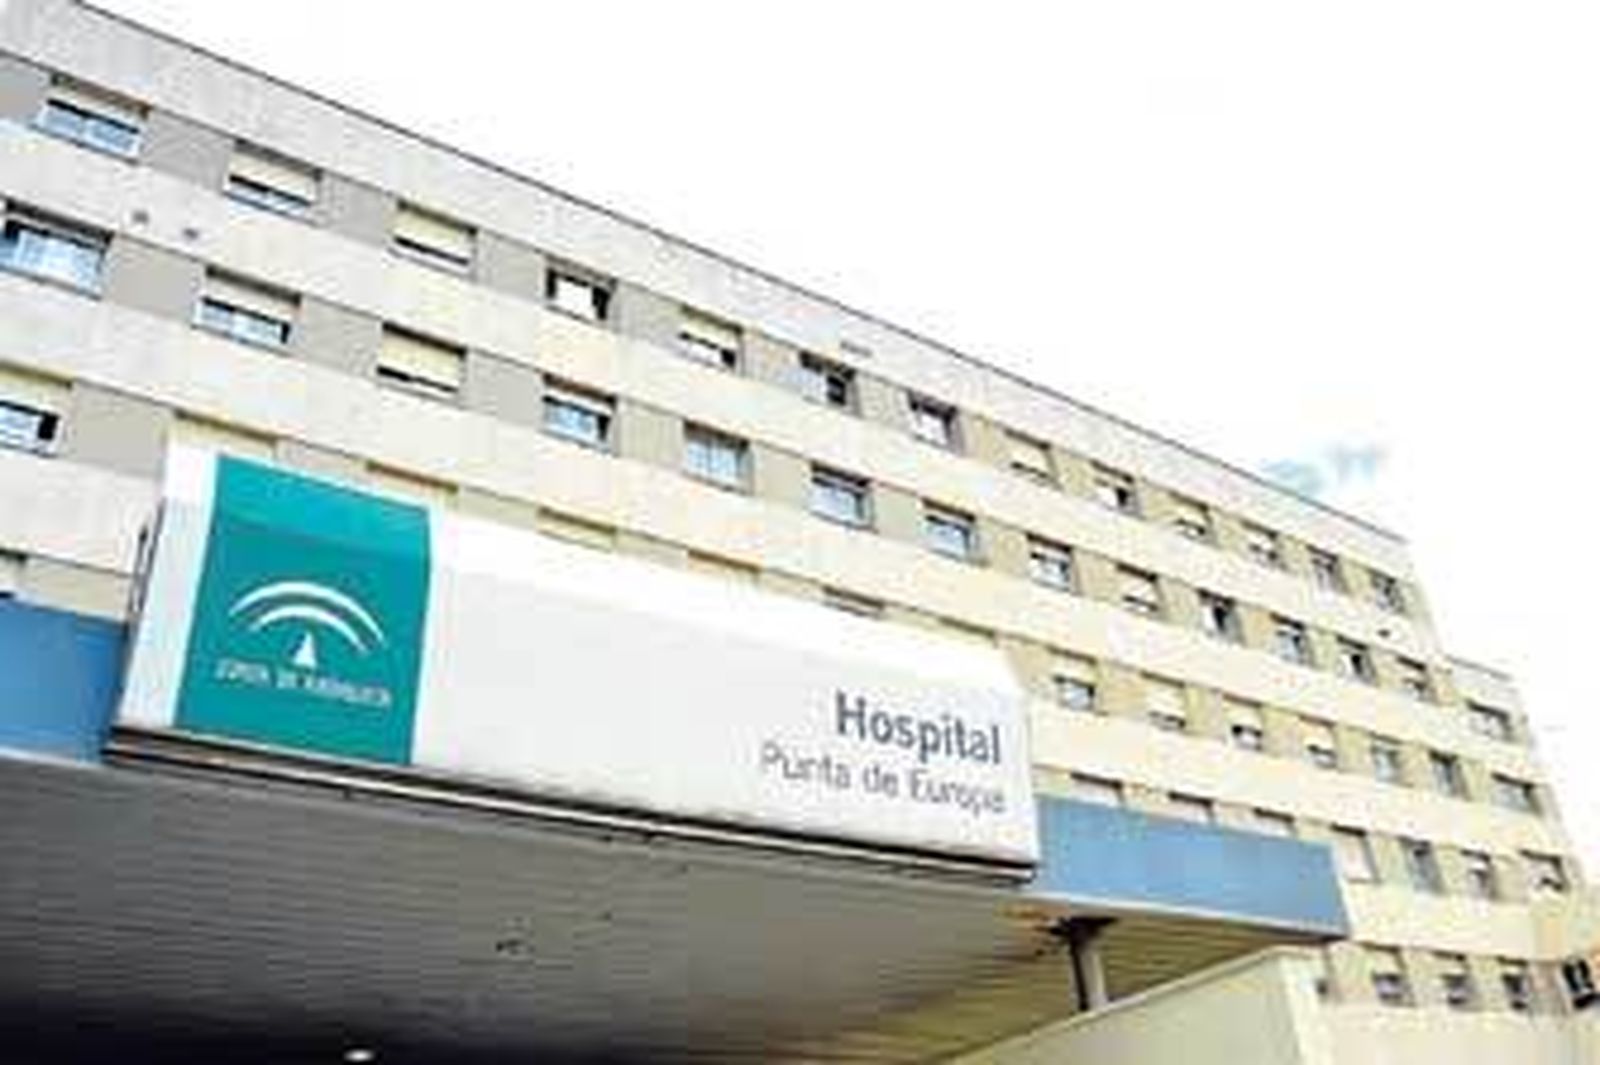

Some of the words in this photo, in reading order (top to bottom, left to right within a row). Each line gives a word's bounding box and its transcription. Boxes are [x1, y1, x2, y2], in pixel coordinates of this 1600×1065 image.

[836, 689, 1001, 765] Hospital
[761, 740, 851, 790] Punta
[862, 763, 899, 798] de
